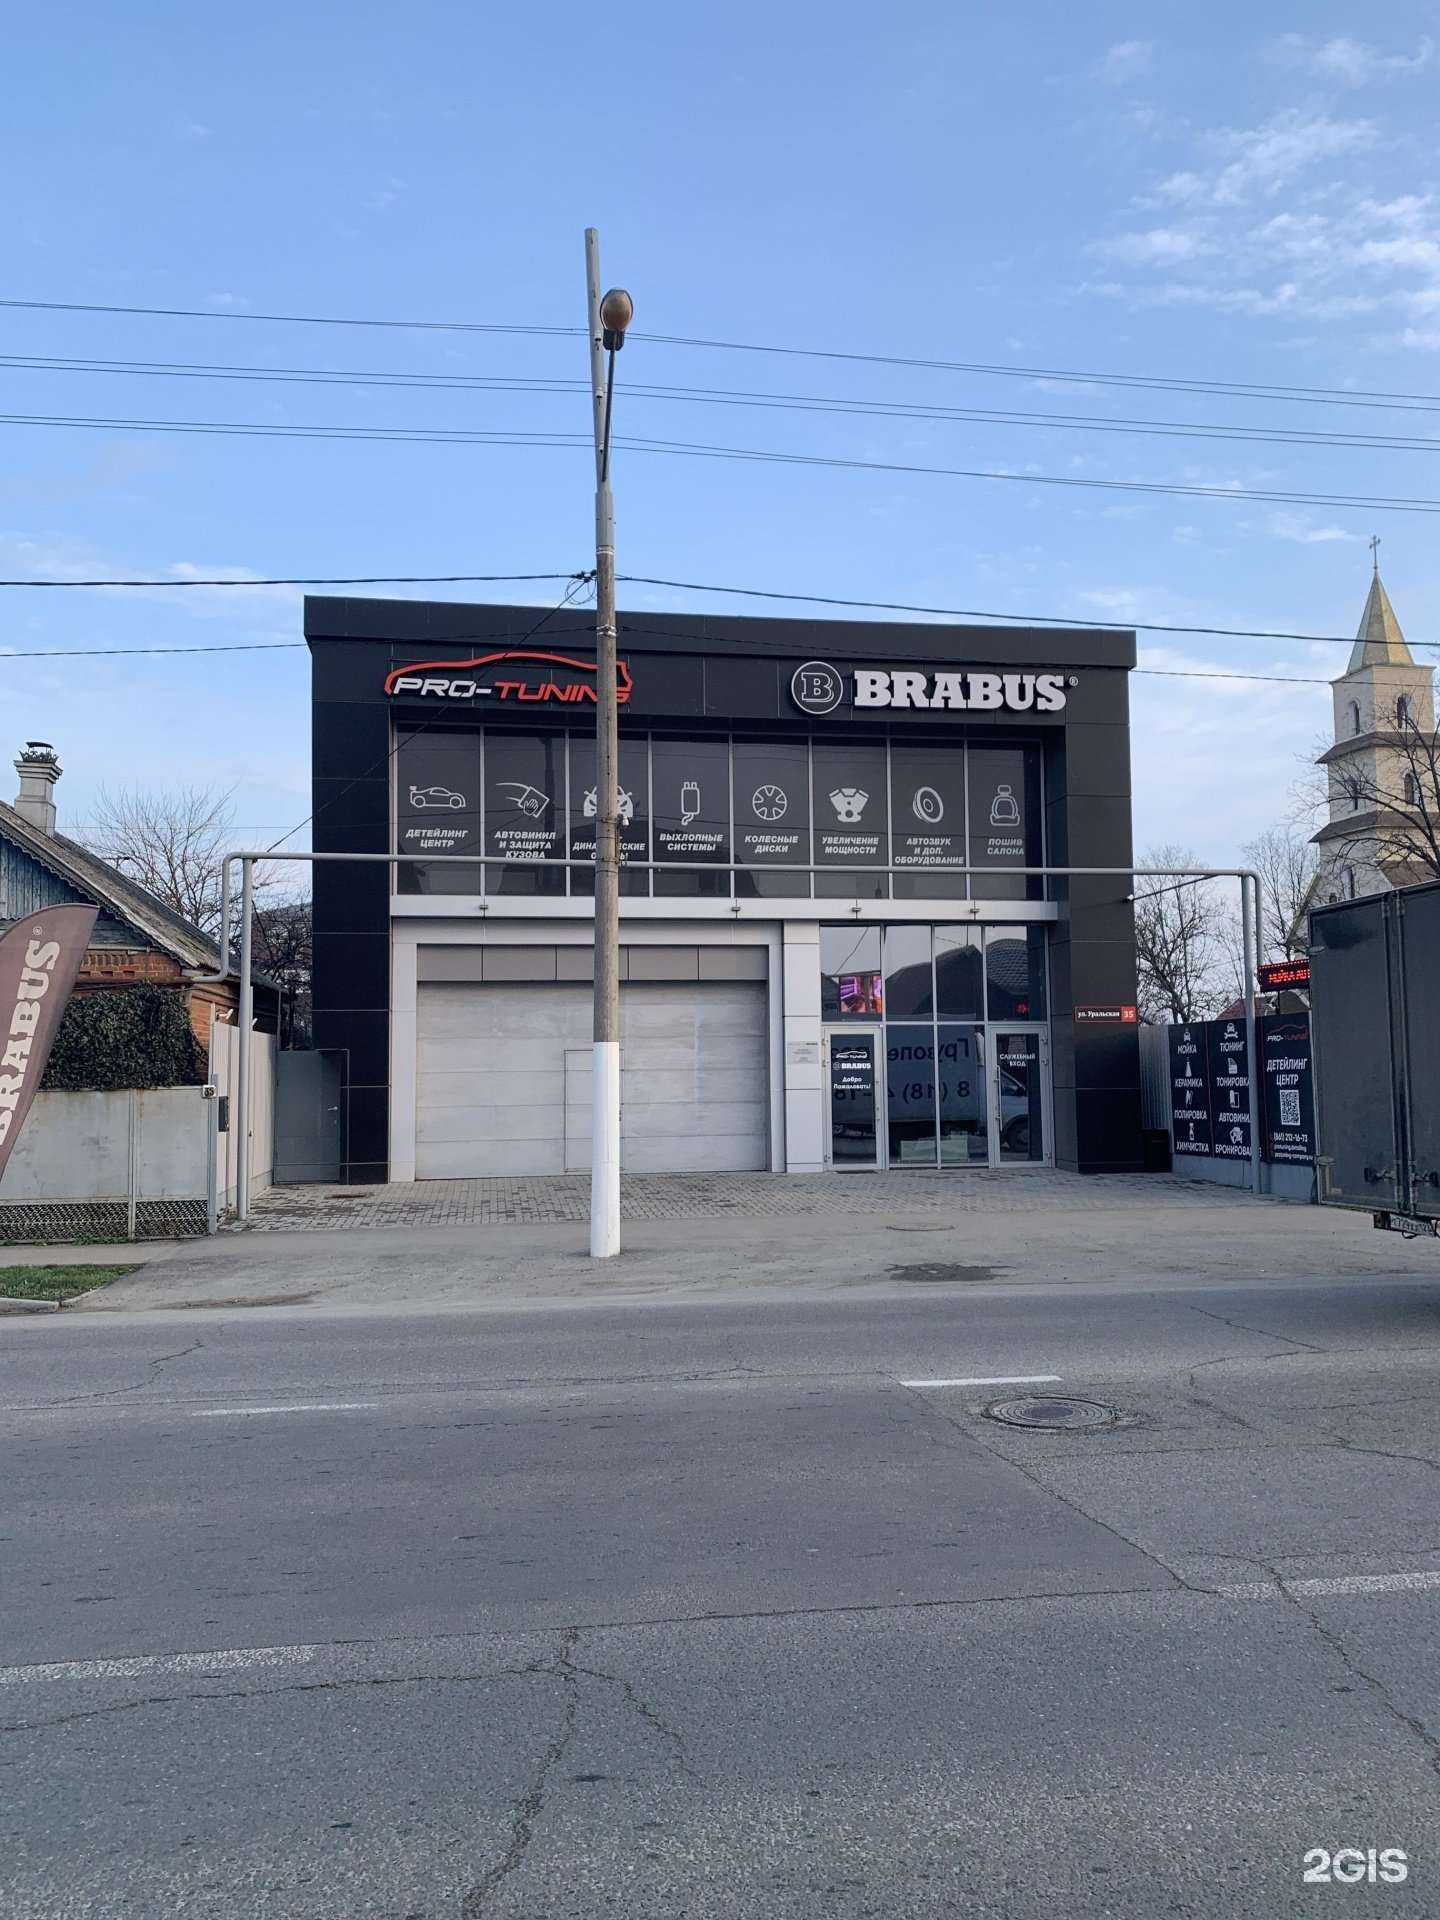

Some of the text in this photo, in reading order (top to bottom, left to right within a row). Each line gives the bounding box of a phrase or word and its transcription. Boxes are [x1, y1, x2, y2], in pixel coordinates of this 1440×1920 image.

[406, 828, 468, 839] ДЕТЕЙЛИНГ
[494, 831, 556, 840] АВТОВИНИЛ
[659, 833, 724, 842] ВЫХЛОПНЫЕ
[420, 839, 455, 848] ЦЕНТР
[744, 835, 799, 844] КОЛЕСНЫЕ
[821, 836, 879, 845] УВЕЛИЧЕНИЕ
[906, 837, 951, 846] АВТОЗВУК
[988, 838, 1023, 846] ПОШИВ
[499, 840, 552, 850] И ЗАЩИТА
[572, 842, 646, 852] ДИНАСКИЕ
[667, 843, 716, 852] СИСТЕМЫ
[754, 844, 789, 854] ДИСКИ
[824, 845, 877, 855] МОЩНОСТИ
[505, 850, 545, 859] КУЗОВА
[914, 847, 944, 856] И ДОП.
[987, 847, 1025, 856] САЛОНА
[894, 855, 964, 865] ОБОРУДОВАНИЕ
[1088, 1010, 1120, 1018] Уральская
[1177, 1042, 1197, 1055] МОЙКА
[1220, 1041, 1245, 1052] ТЮНИНГ
[1266, 1056, 1308, 1072] ДЕТЕЙЛИНГ
[1175, 1078, 1203, 1088] КЕРАМИКА
[1276, 1074, 1299, 1087] ЦЕНТР
[1174, 1110, 1208, 1120] ПОЛИРОВКА
[1218, 1112, 1251, 1123] АВТОВИНИ
[1176, 1141, 1210, 1153] ХИМЧИСТКА
